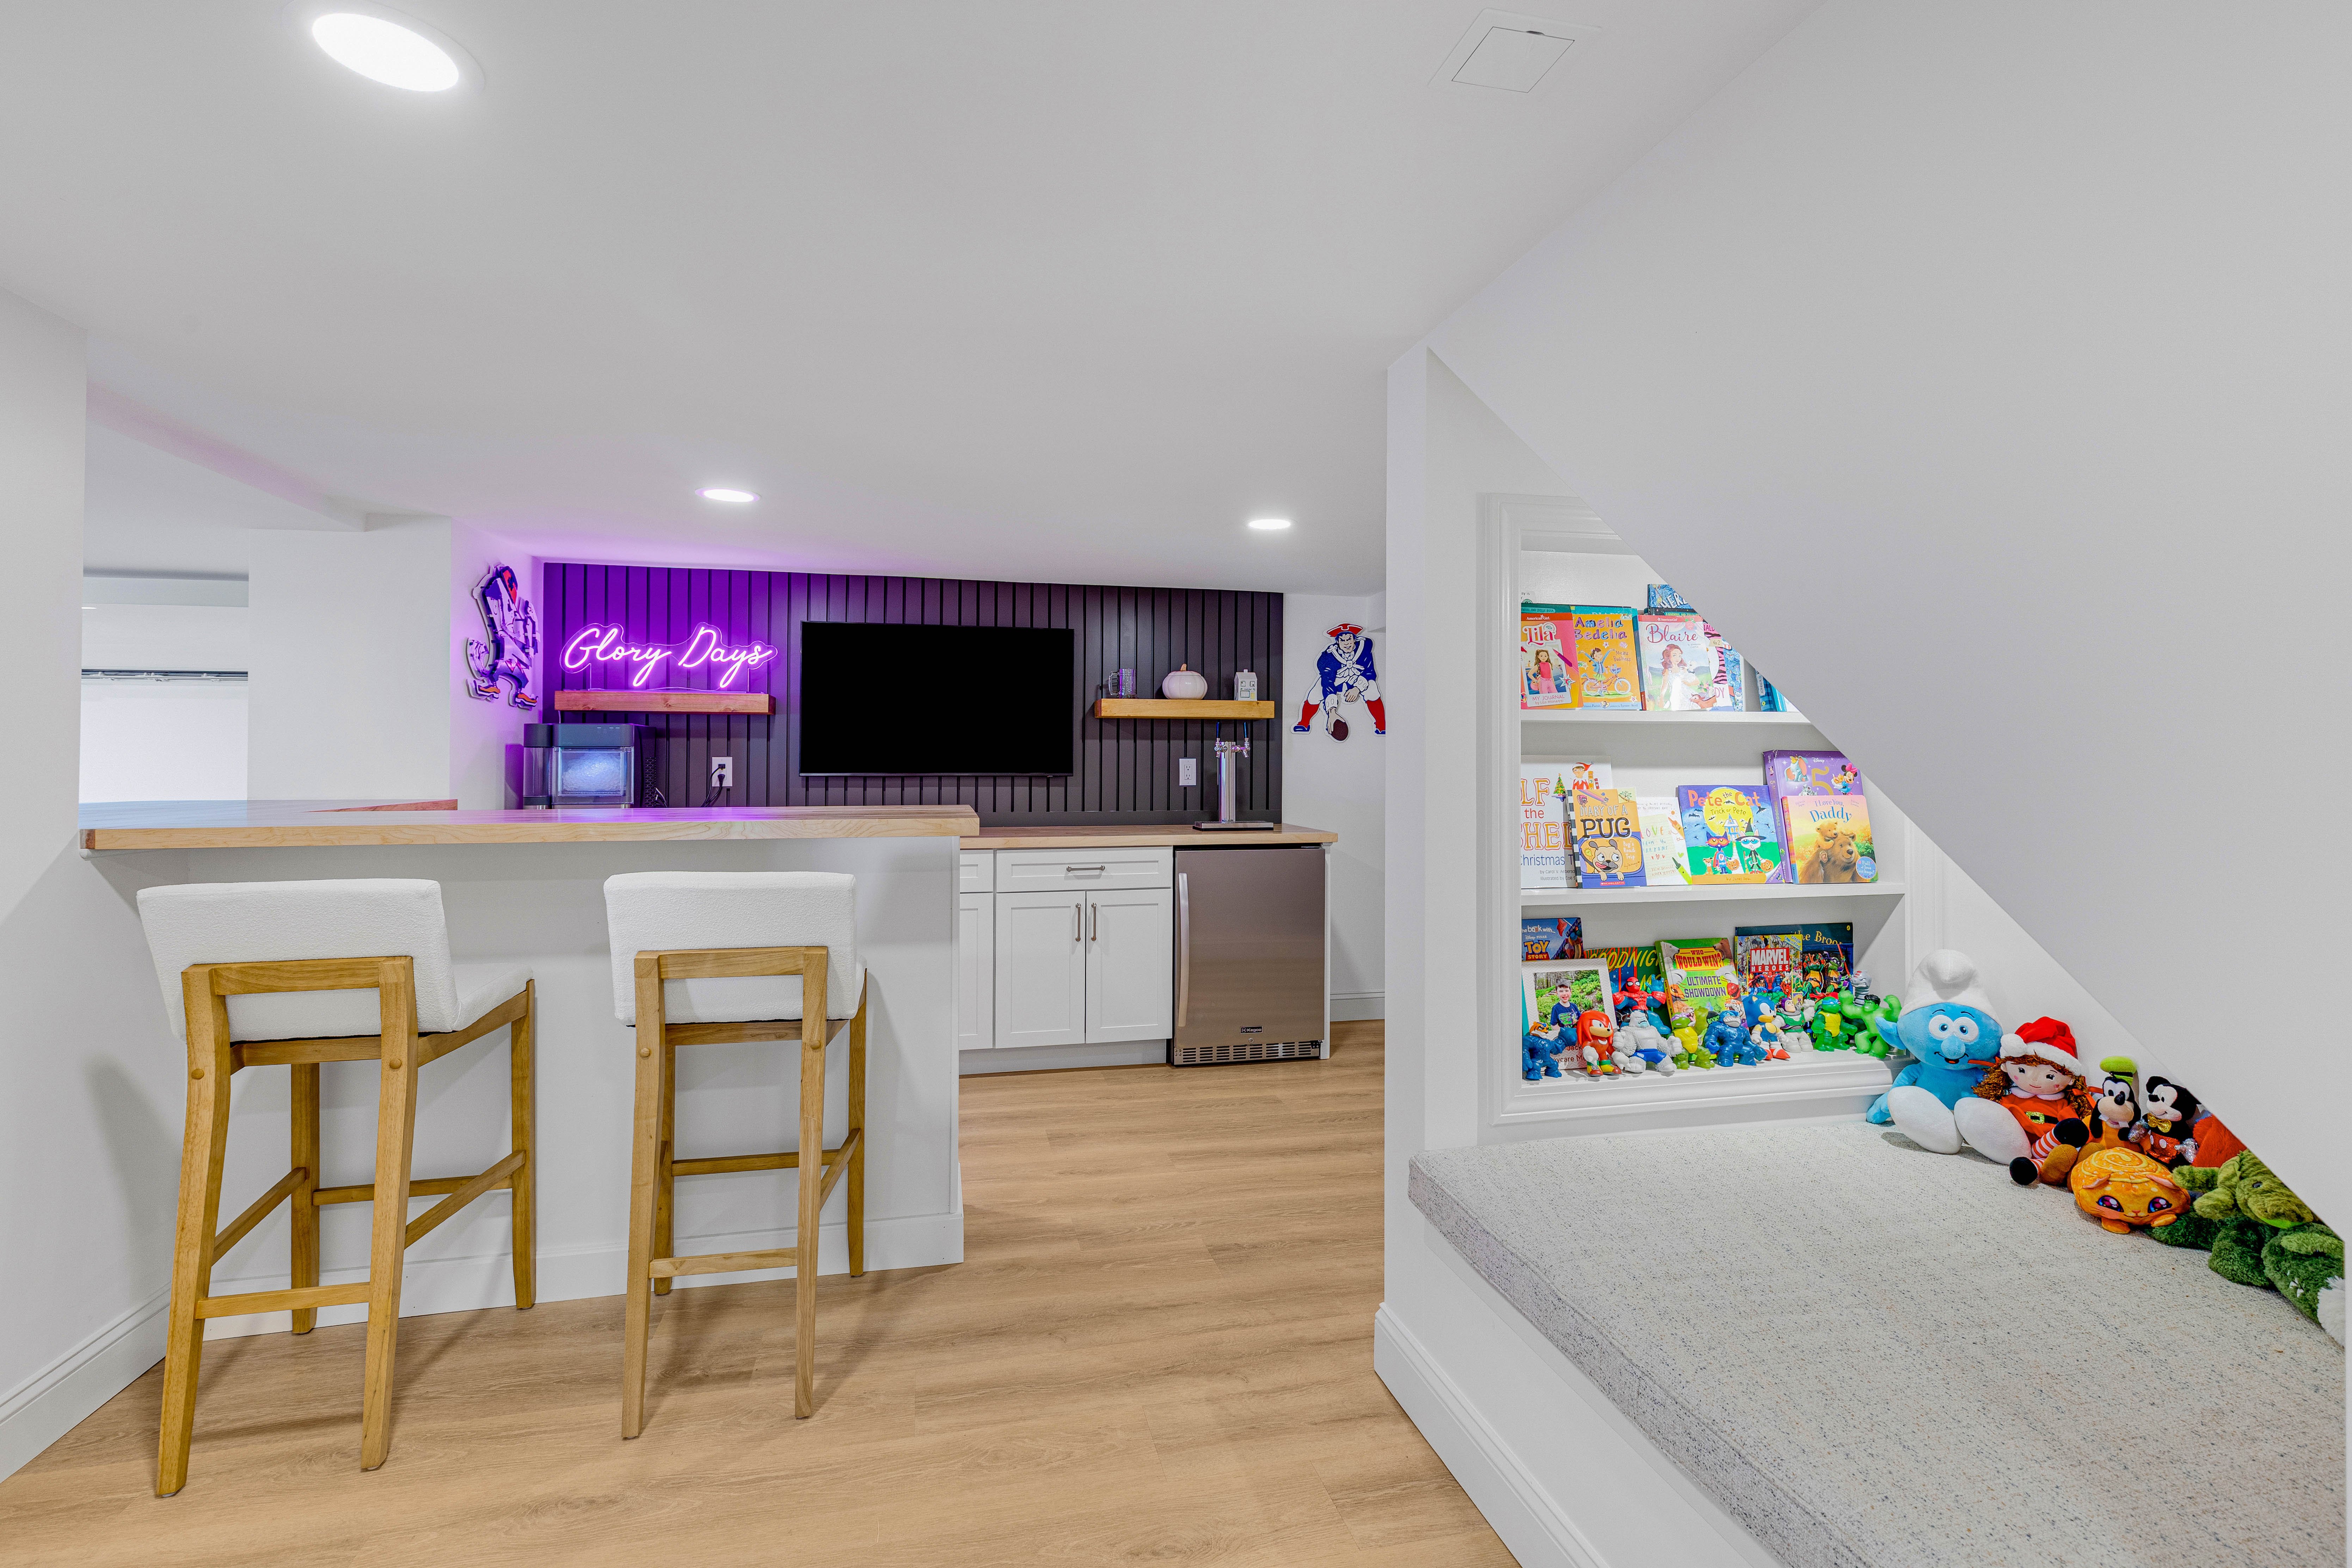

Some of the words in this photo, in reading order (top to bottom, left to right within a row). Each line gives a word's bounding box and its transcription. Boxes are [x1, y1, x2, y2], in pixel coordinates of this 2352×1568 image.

[1575, 617, 1623, 628] Amelia
[1524, 626, 1553, 645] Lila
[1574, 629, 1627, 640] Bedelia
[1646, 623, 1698, 643] Blaire
[565, 628, 672, 687] Glory
[678, 627, 772, 688] Days
[1811, 766, 1834, 795] 5
[1521, 778, 1550, 806] LF
[1688, 790, 1722, 807] Pete
[1735, 791, 1761, 807] Cat
[1524, 808, 1545, 819] the
[1580, 806, 1605, 817] DIARY
[1607, 805, 1619, 816] OF
[1622, 804, 1628, 816] A
[1733, 807, 1747, 816] Pete
[1809, 806, 1852, 824] Daddy
[1580, 817, 1632, 839] PUG
[1521, 854, 1565, 866] hristmas
[1527, 924, 1543, 933] book
[1524, 940, 1550, 954] TOY
[1676, 955, 1702, 969] WOULD
[1702, 953, 1722, 967] WIN?
[1751, 949, 1788, 966] MARVEL
[1687, 976, 1721, 986] ULTIMATE
[1684, 987, 1727, 998] SHOWDOWN
[1707, 1015, 1720, 1024] BOOKS
